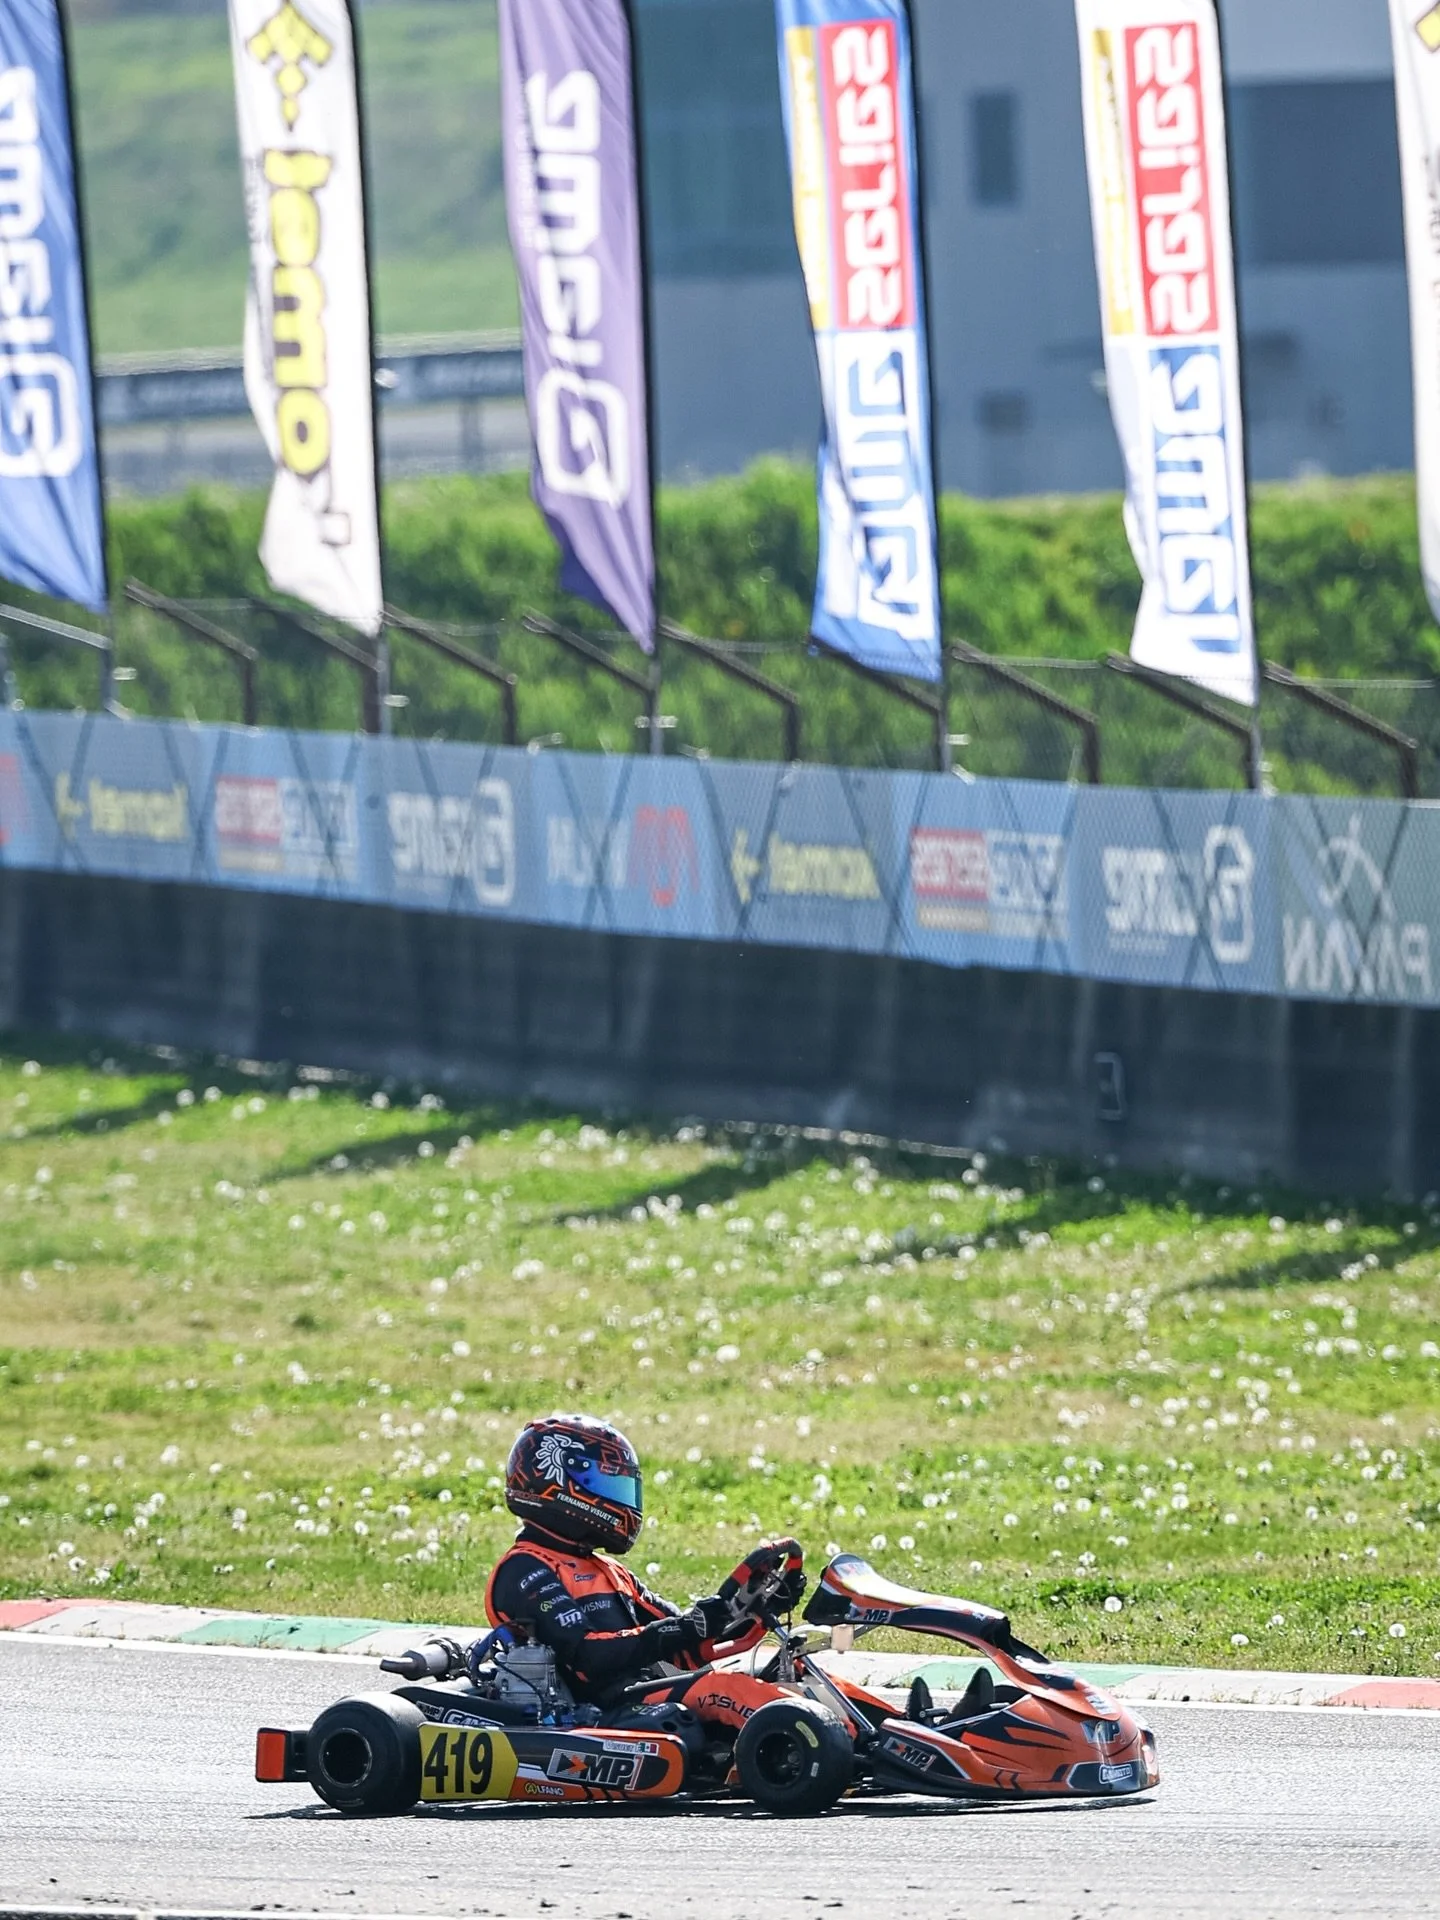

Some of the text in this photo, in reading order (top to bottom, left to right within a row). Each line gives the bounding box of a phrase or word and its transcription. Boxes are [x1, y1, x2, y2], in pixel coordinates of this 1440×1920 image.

[557, 1493, 590, 1511] FERNANDO
[590, 1506, 612, 1521] VISUET
[698, 1693, 756, 1719] VISUE
[423, 1732, 494, 1795] 419
[525, 1782, 564, 1796] ALFANO
